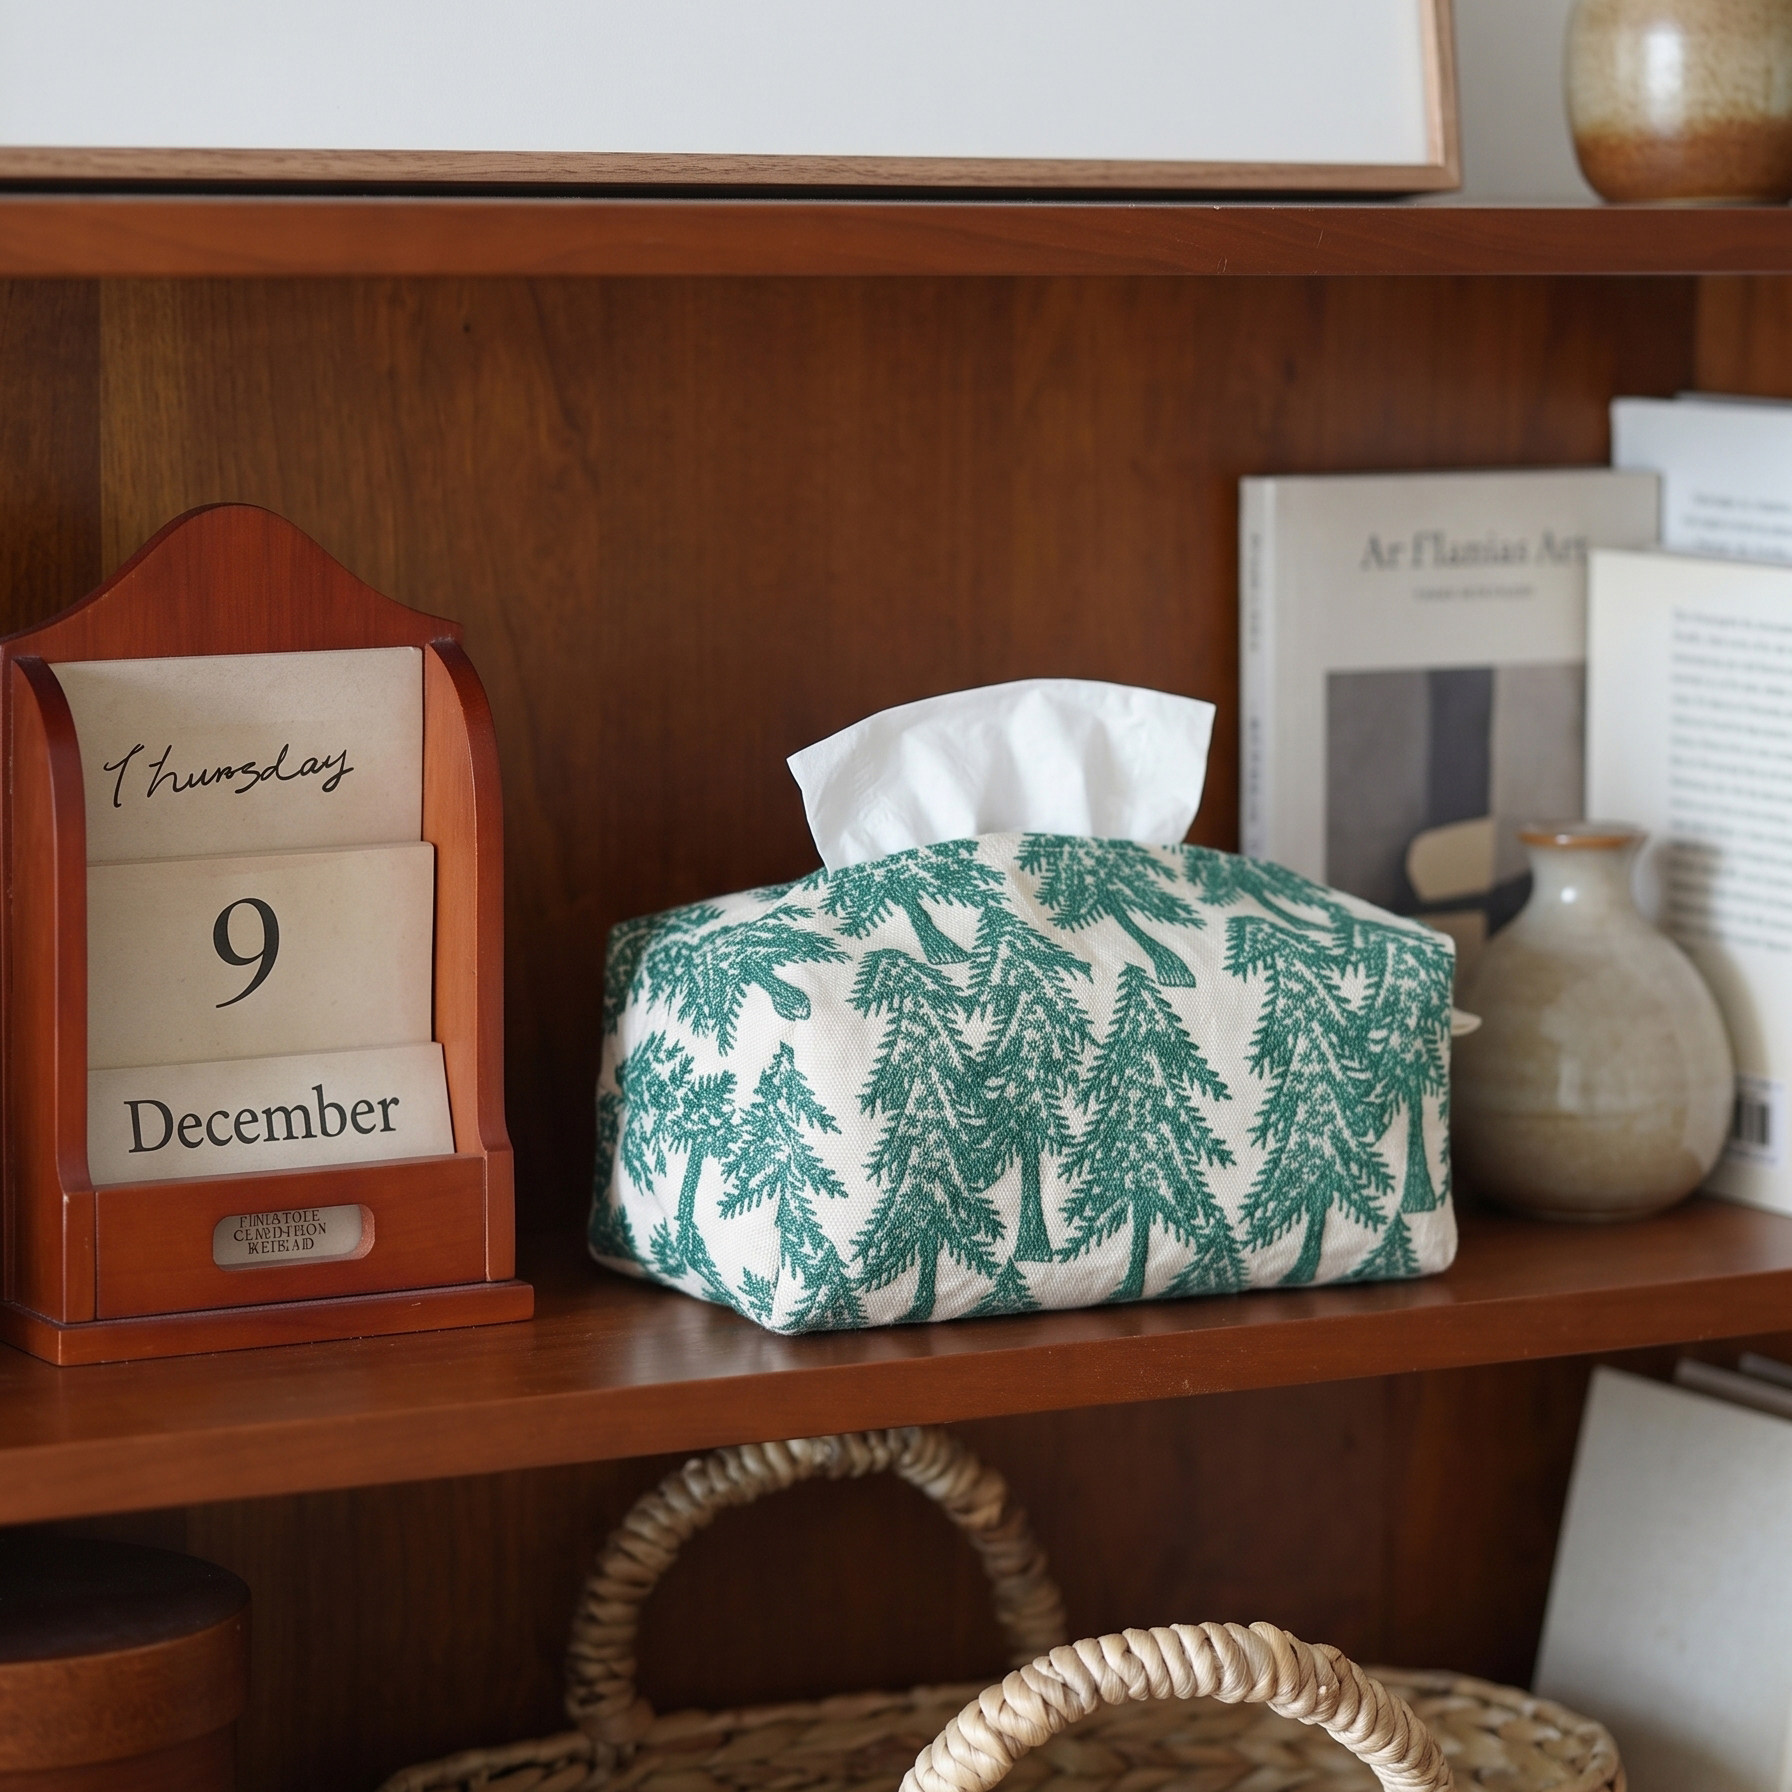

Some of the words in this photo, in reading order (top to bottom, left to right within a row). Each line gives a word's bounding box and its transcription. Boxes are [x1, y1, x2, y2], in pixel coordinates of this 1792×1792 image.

[103, 743, 354, 808] Thursday
[212, 897, 280, 1009] 9
[123, 1083, 400, 1153] December
